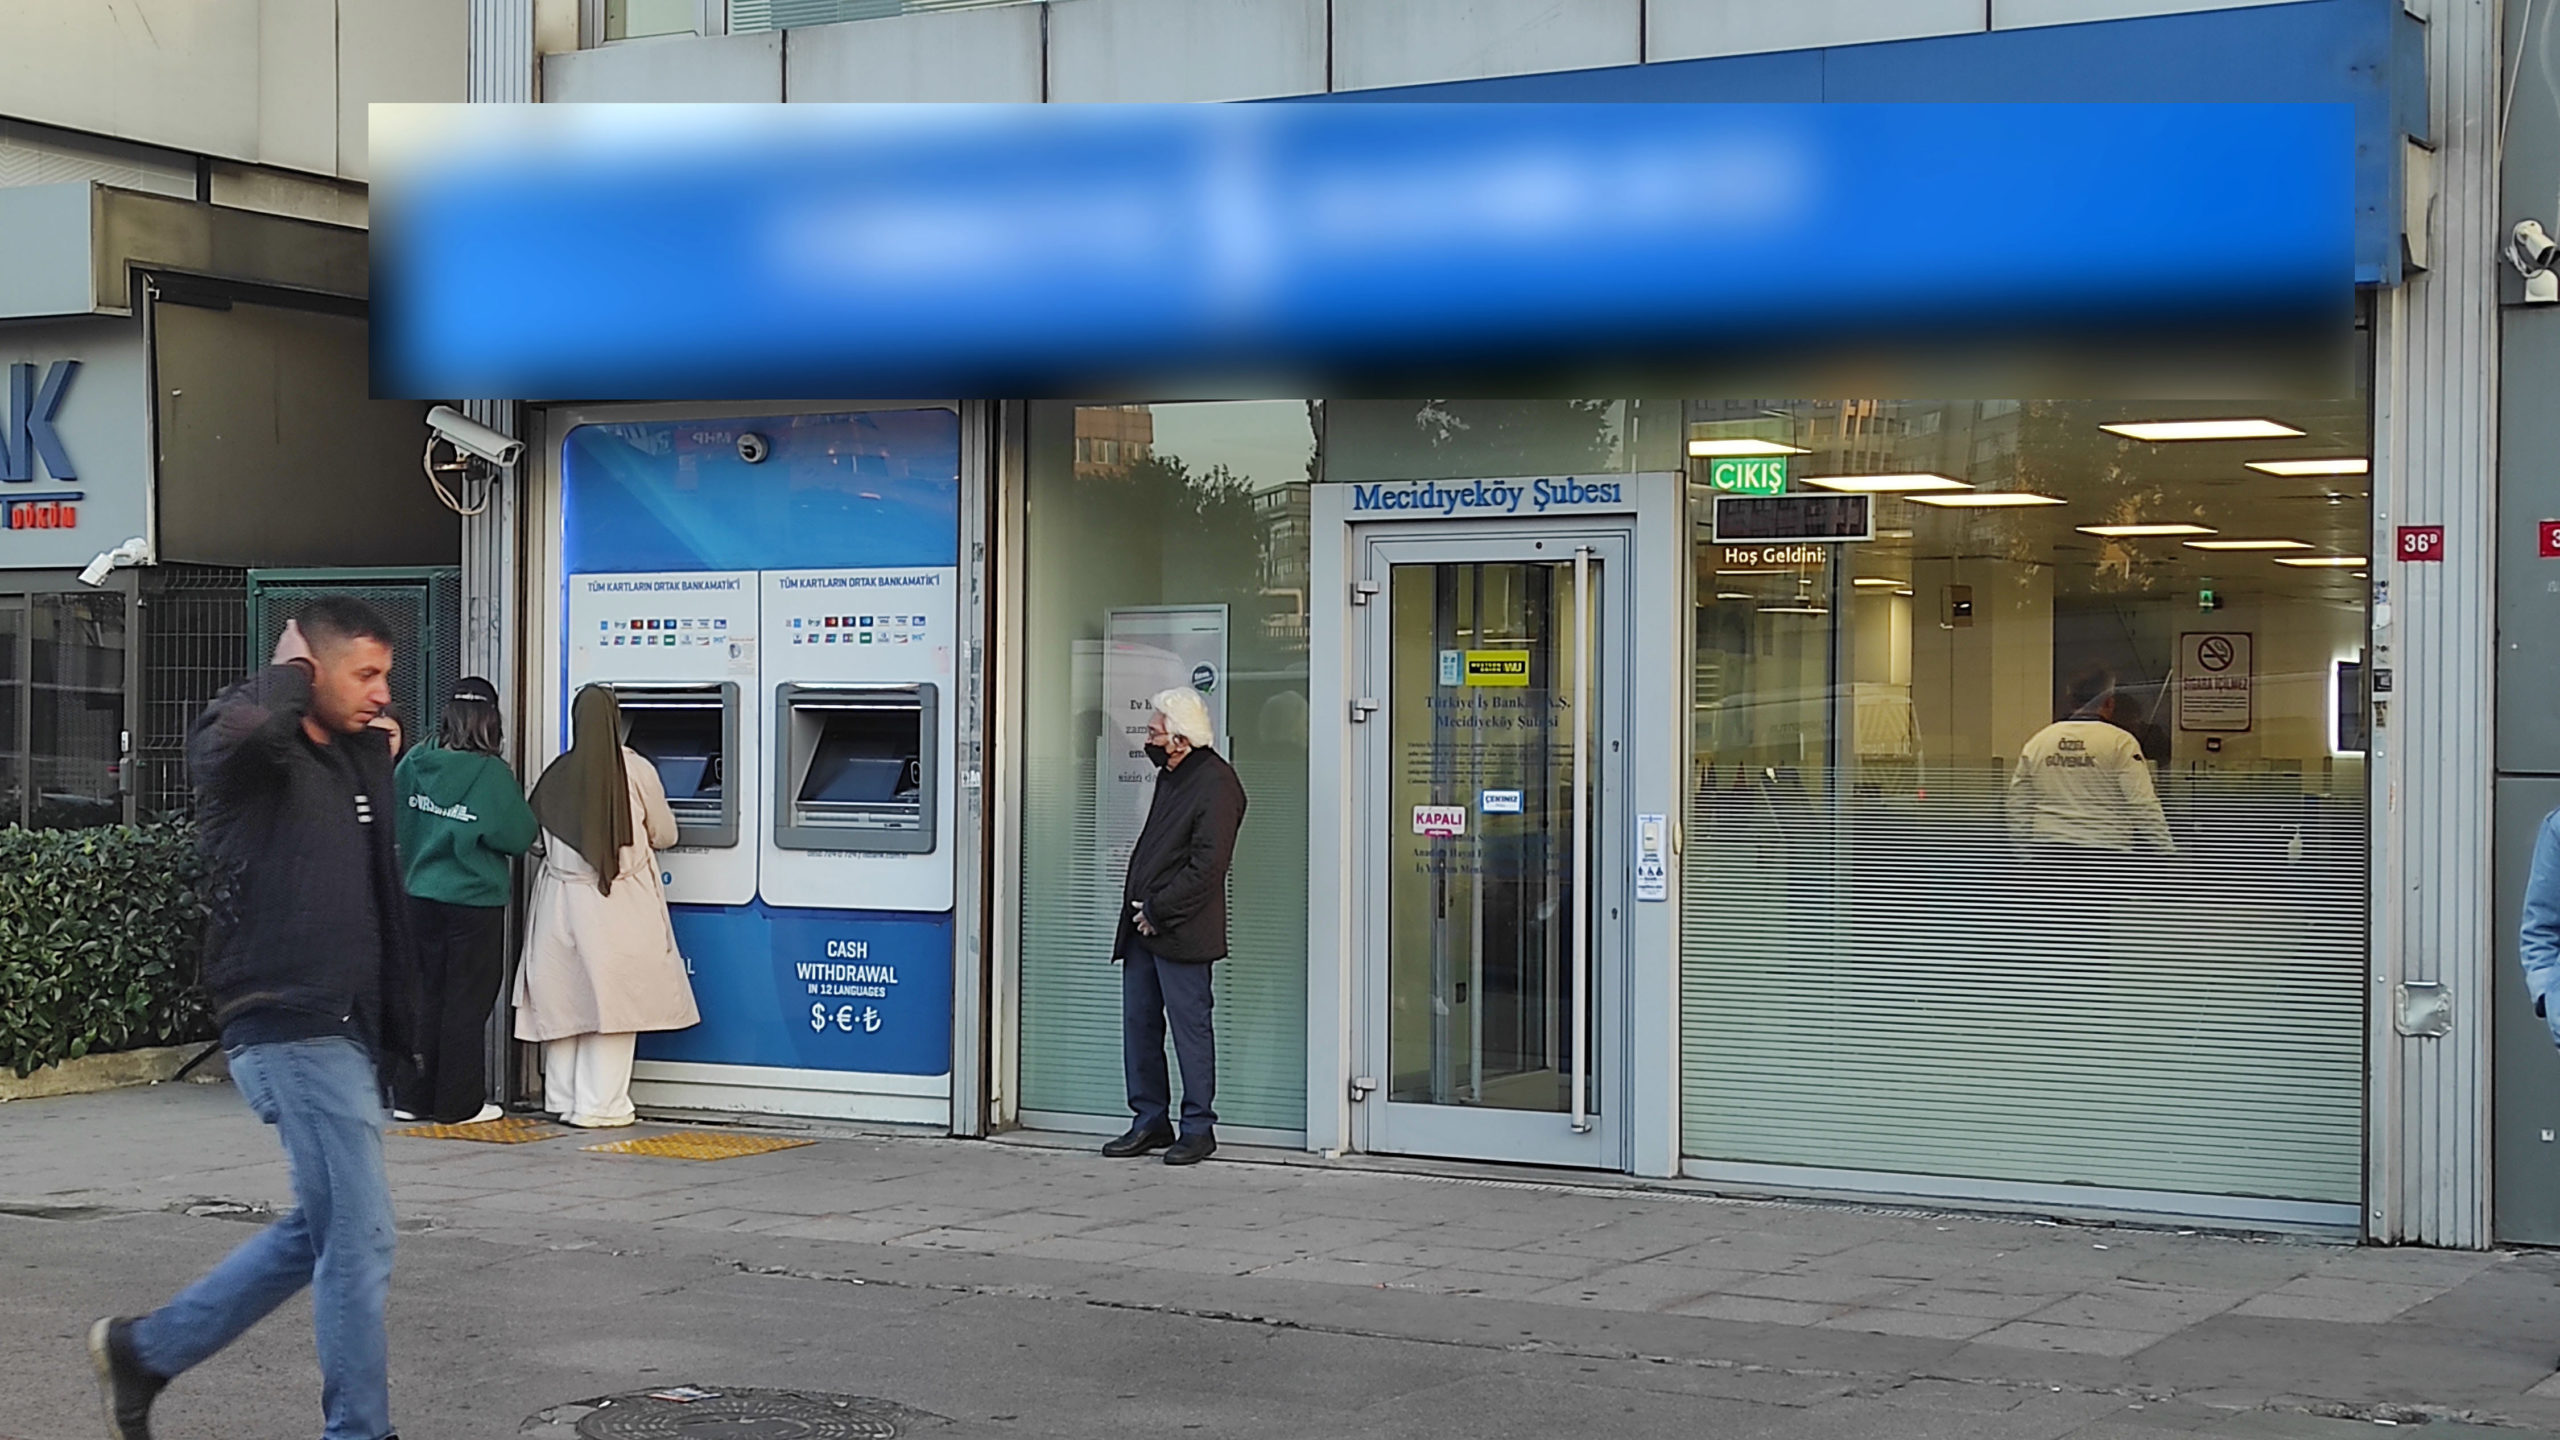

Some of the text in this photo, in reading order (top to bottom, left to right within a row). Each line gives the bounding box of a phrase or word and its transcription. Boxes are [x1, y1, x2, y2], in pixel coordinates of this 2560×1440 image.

[1725, 547, 1758, 565] Hoş
[588, 580, 606, 592] TÜM
[607, 580, 652, 592] KARTLARIN
[654, 580, 680, 591] ORTAK
[779, 576, 798, 589] TÜM
[800, 576, 847, 588] KARTLARIN
[849, 576, 877, 588] ORTAK
[1416, 812, 1462, 826] KAPALI
[827, 940, 868, 959] CASH
[796, 962, 898, 984] WITHDRAWAL
[808, 983, 886, 998] IN 12 LANGUAGES
